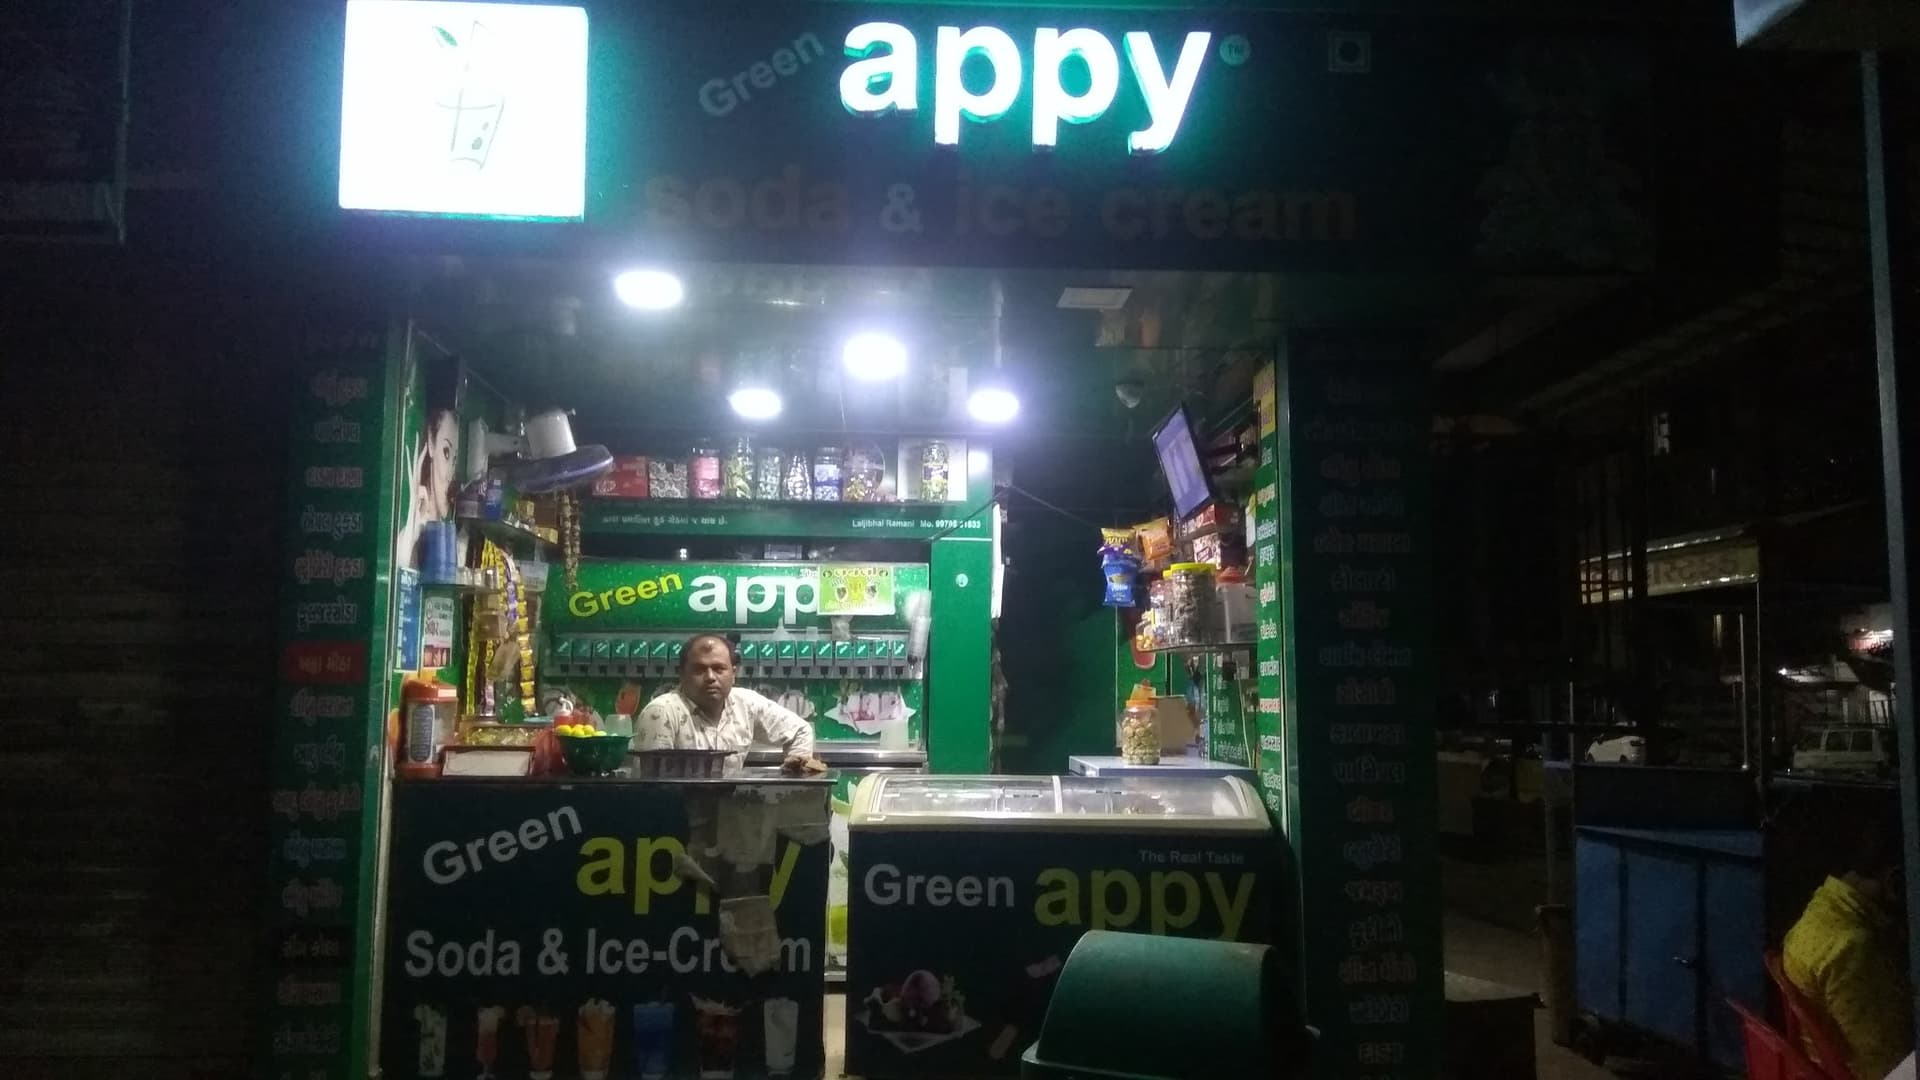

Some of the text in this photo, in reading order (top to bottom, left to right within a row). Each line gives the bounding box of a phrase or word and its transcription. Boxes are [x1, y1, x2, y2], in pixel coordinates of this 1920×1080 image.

[699, 20, 1213, 155] Green appy
[643, 164, 1359, 241] soda & ice cream
[886, 519, 915, 528] Ramani
[920, 519, 934, 528] Mo.
[568, 571, 683, 618] Green
[687, 574, 819, 624] app
[422, 804, 583, 886] Green
[1138, 848, 1246, 866] The Real Taste
[863, 863, 1257, 940] Green appy
[404, 926, 811, 978] Soda & Ice-Crm
